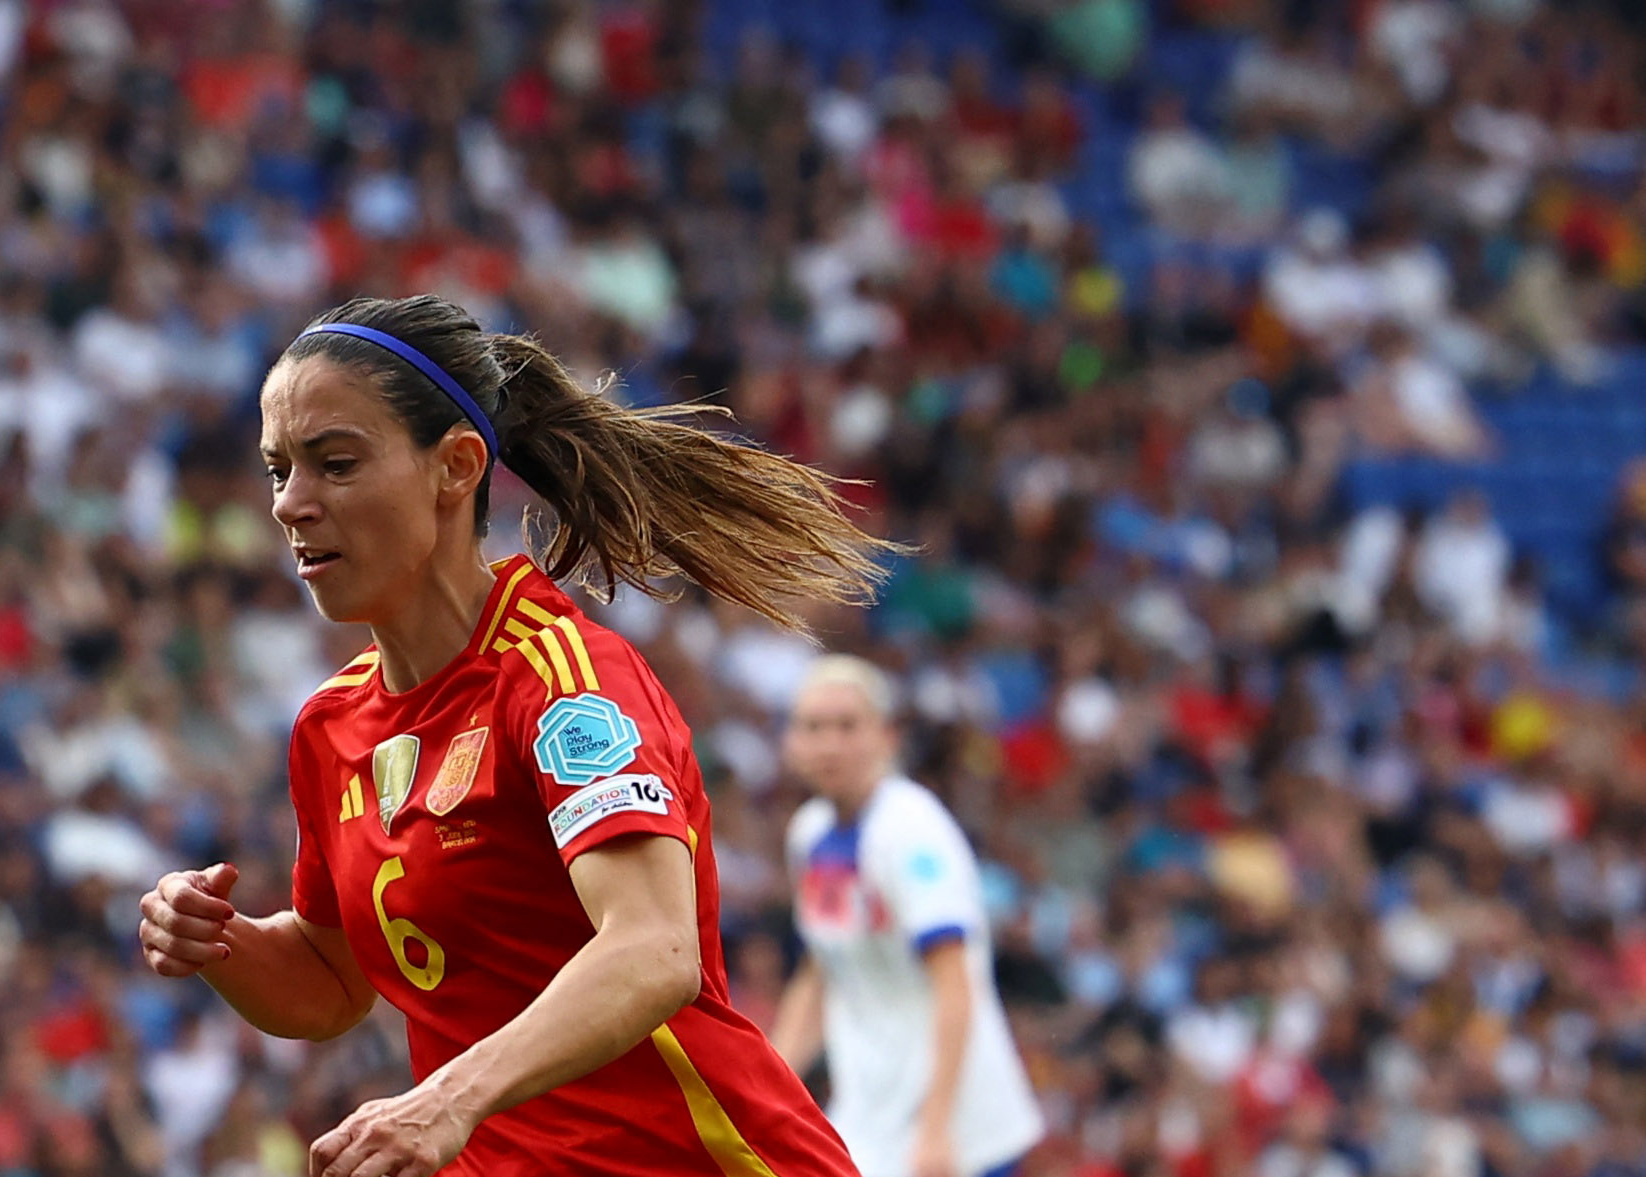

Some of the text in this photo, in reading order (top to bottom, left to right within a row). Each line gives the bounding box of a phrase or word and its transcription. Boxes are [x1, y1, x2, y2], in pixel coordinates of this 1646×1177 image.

[563, 726, 581, 736] We
[569, 739, 610, 756] Strong
[553, 788, 631, 833] FOUNDATION
[372, 856, 445, 991] 6
